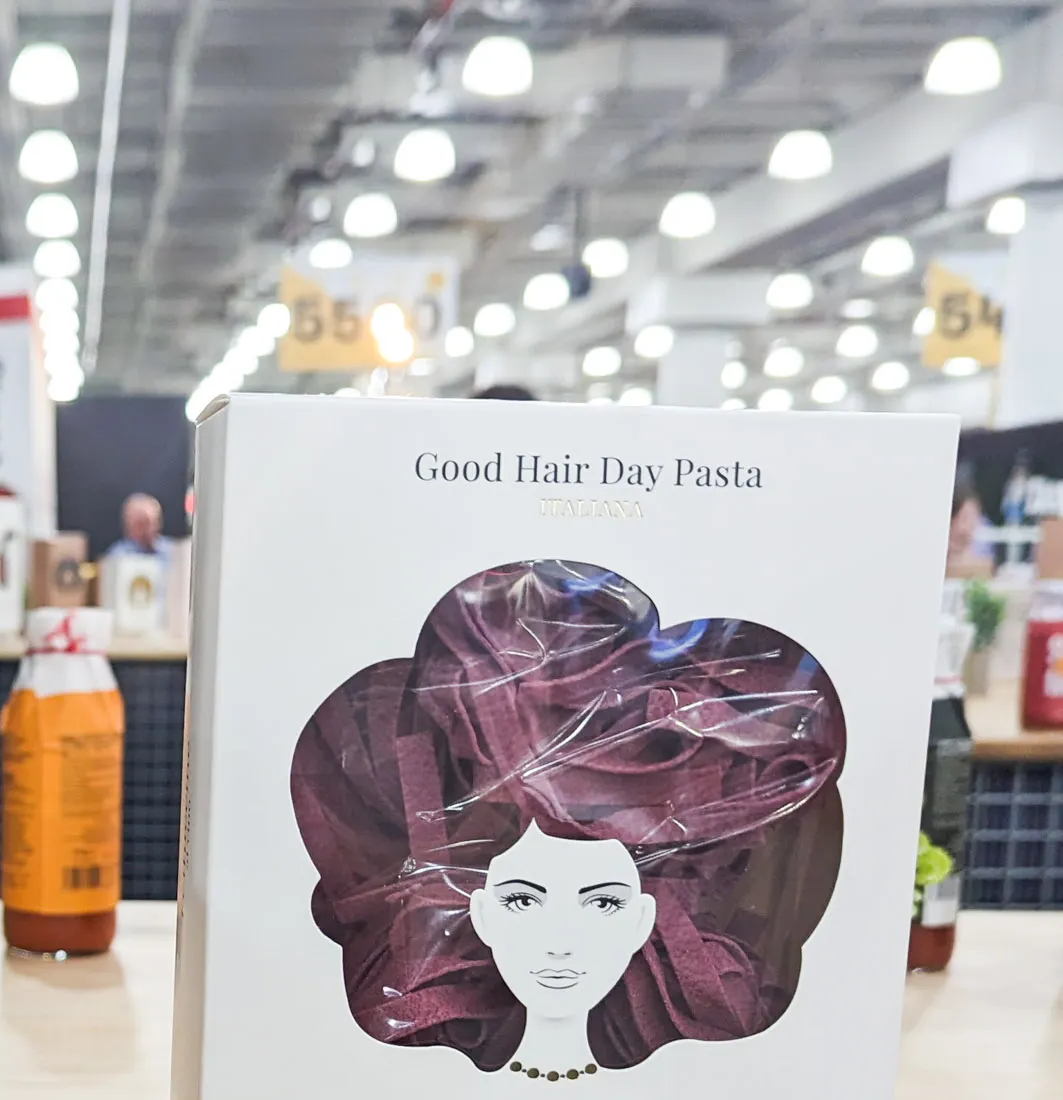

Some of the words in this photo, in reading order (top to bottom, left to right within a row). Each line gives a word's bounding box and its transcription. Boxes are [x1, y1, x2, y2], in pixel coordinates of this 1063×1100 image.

[293, 294, 442, 344] 550
[414, 451, 503, 483] Good
[514, 454, 590, 485] Hair
[599, 456, 664, 493] Day
[673, 457, 764, 489] Pasta
[538, 498, 645, 520] ITALIANA
